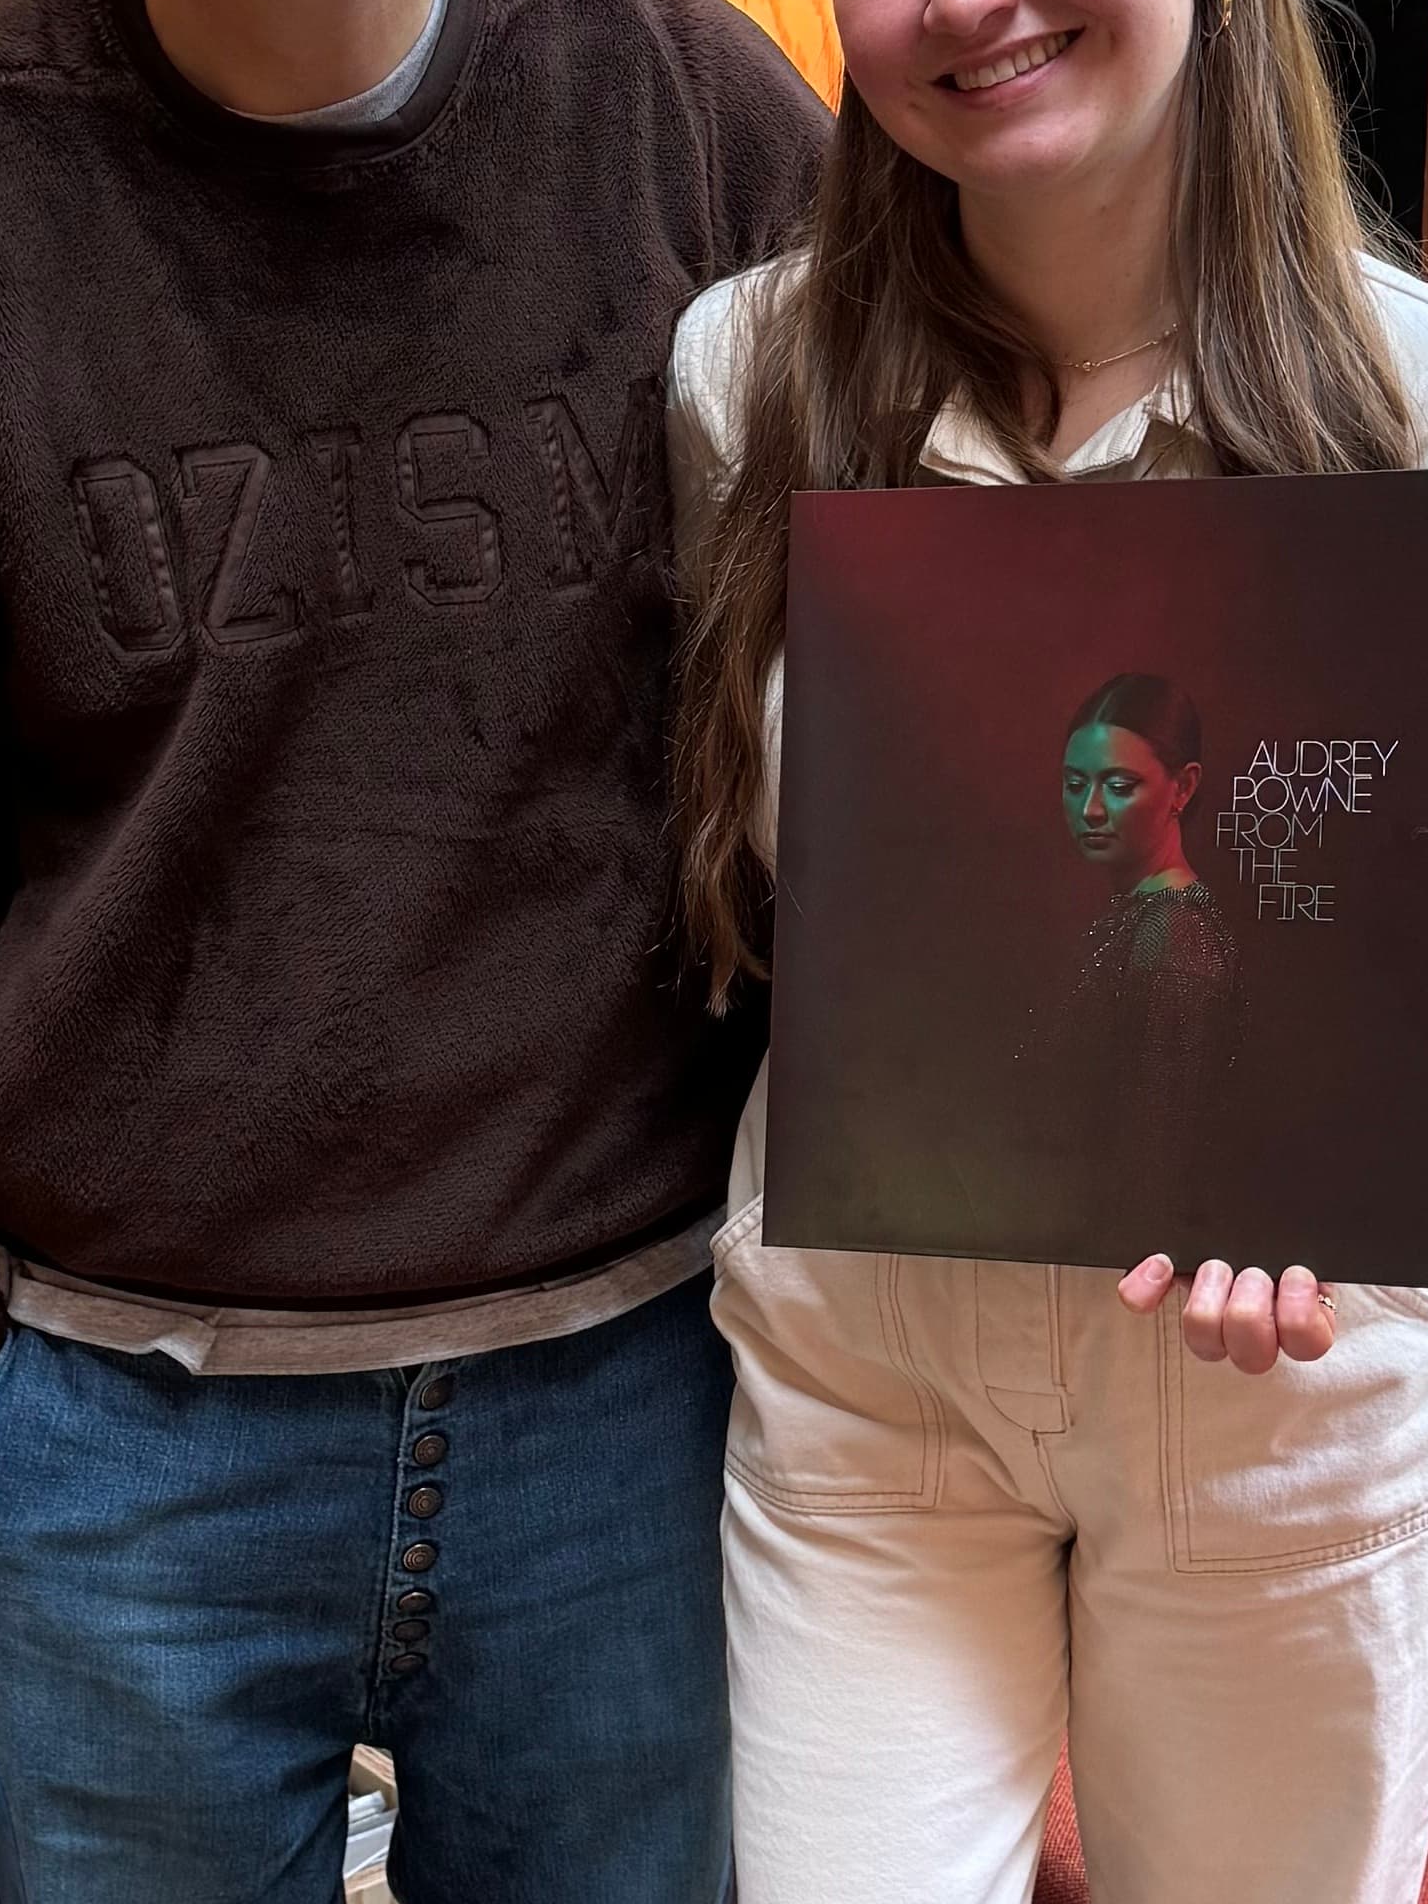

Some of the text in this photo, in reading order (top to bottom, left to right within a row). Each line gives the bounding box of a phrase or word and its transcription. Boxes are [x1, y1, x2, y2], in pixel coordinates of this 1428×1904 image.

[1247, 739, 1400, 778] AUDREY
[1232, 776, 1373, 814] POWNE
[1215, 812, 1323, 850] FROM
[1231, 848, 1298, 885] THE
[1257, 884, 1336, 922] FIRE
